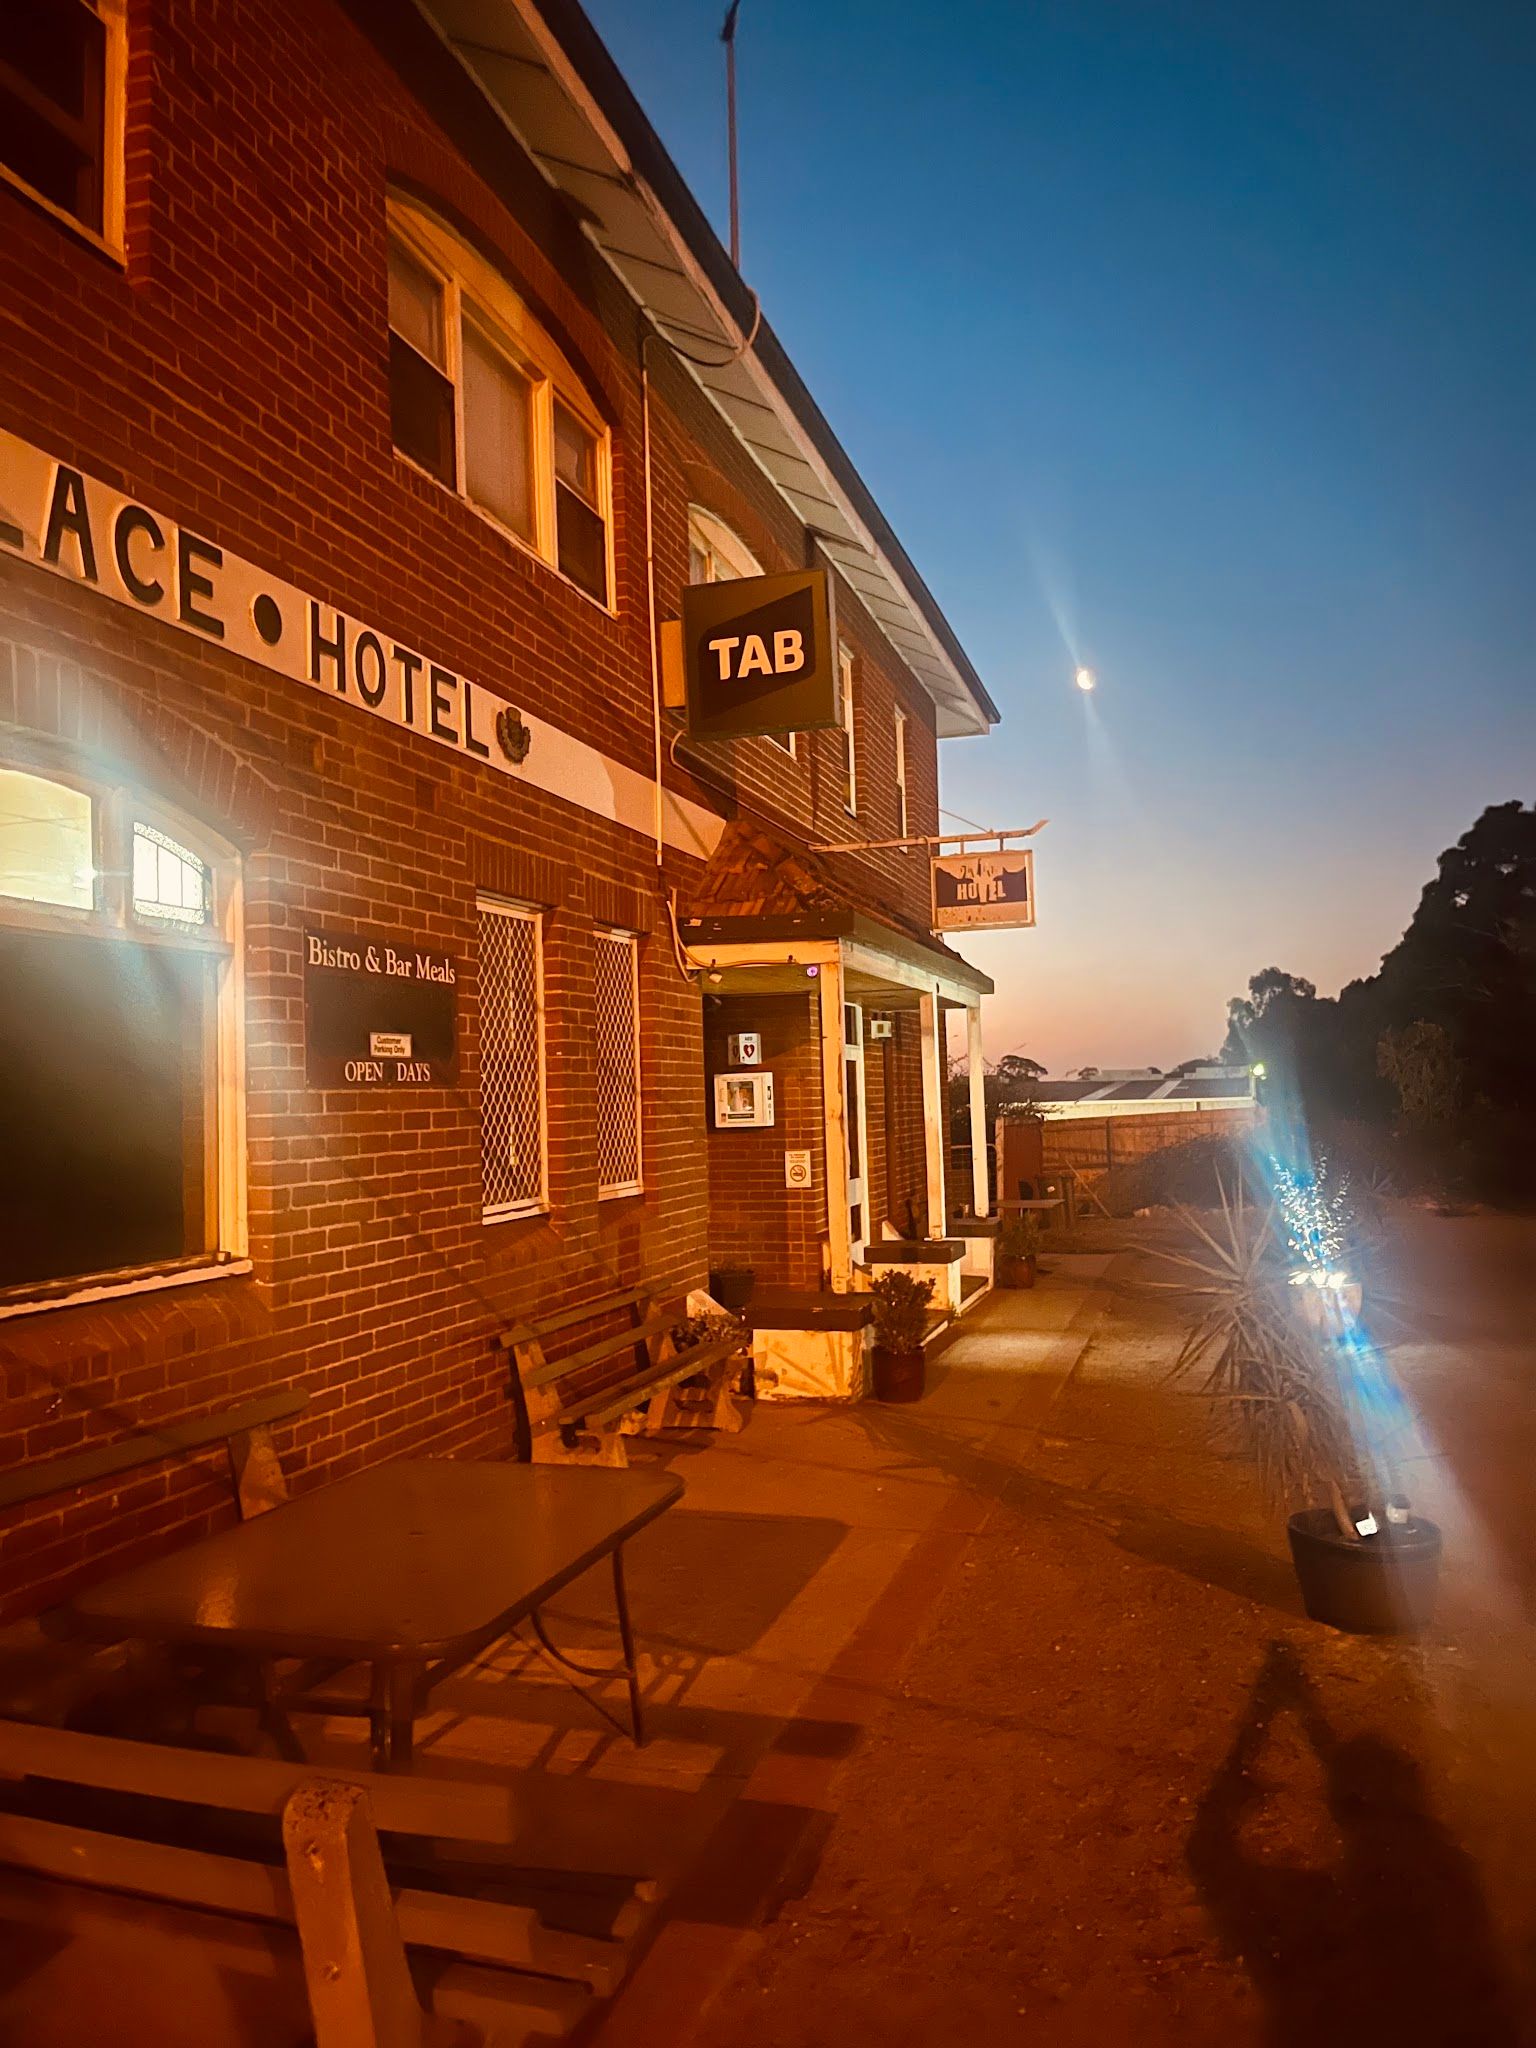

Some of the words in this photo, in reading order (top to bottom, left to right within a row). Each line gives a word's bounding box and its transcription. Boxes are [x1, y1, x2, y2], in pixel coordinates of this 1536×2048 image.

[0, 465, 225, 639] ACE
[308, 600, 489, 758] HOTEL
[708, 629, 805, 681] TAB
[307, 935, 361, 971] Bistro
[365, 945, 382, 974] &
[385, 948, 412, 977] Bar
[415, 953, 456, 984] Meals
[344, 1061, 384, 1082] OPEN
[396, 1062, 431, 1082] DAYS
[373, 1044, 393, 1055] Parking
[394, 1045, 405, 1055] Only
